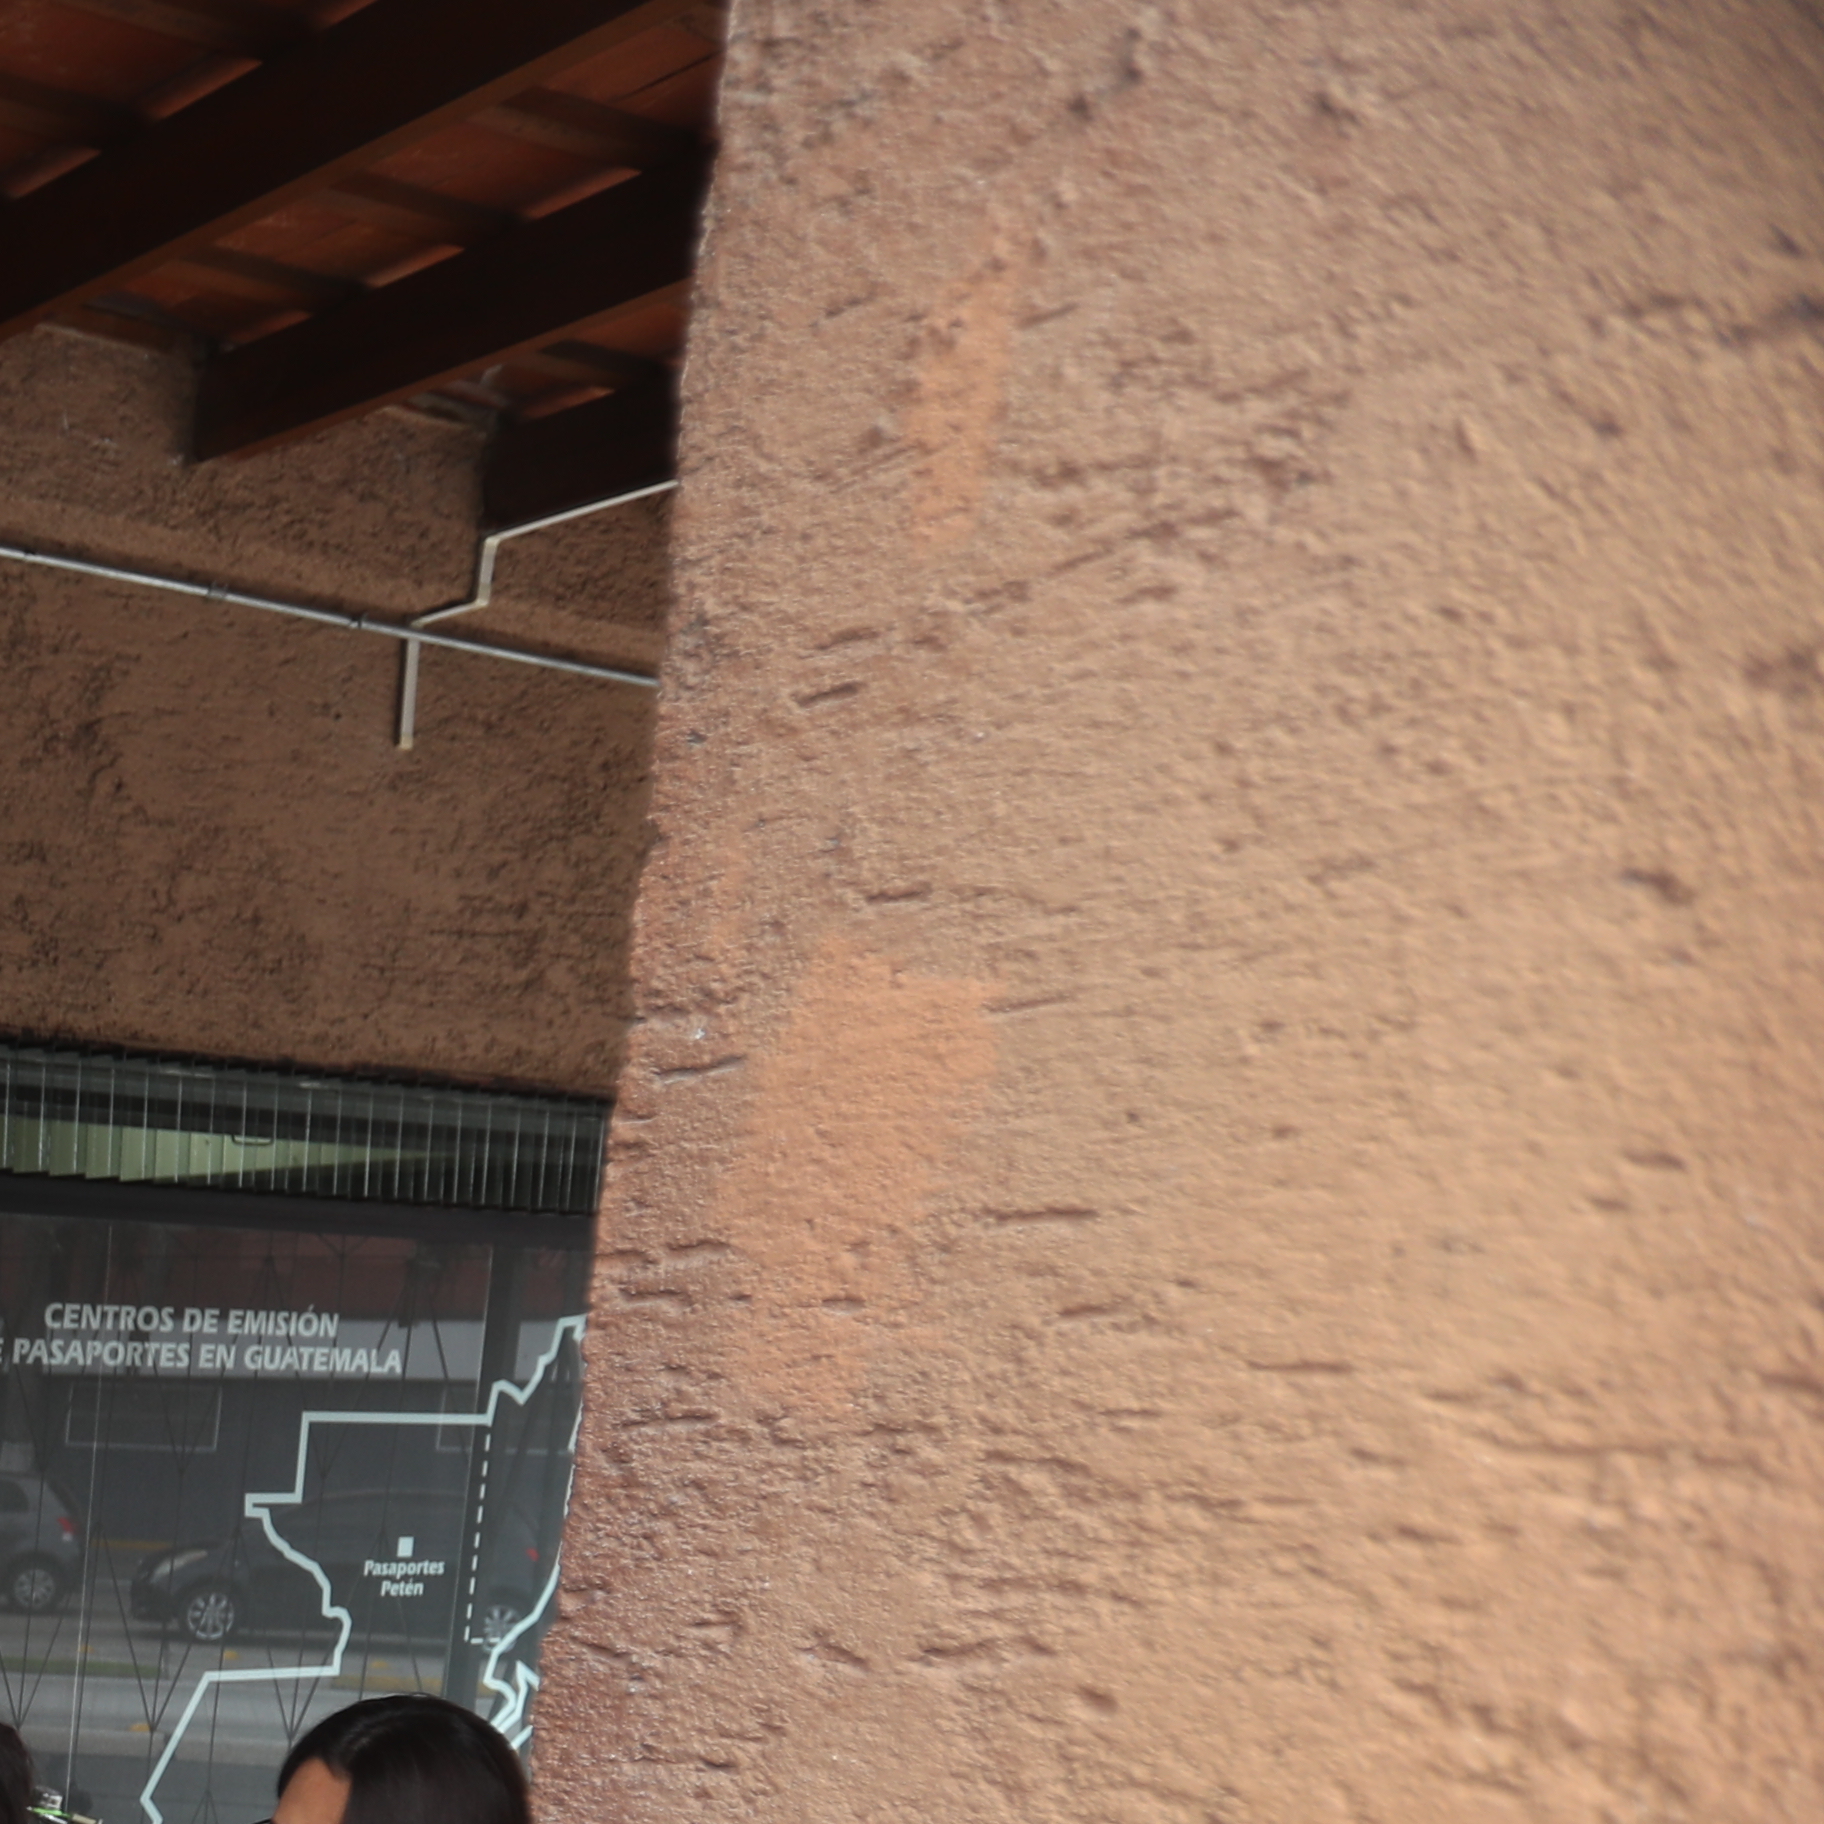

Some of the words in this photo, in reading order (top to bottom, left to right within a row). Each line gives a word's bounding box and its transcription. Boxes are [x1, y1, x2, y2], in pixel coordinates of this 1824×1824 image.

[44, 1302, 175, 1333] CENTROS
[182, 1307, 220, 1334] DE
[227, 1303, 340, 1338] EMISIÓN
[12, 1338, 191, 1369] PASAPORTES
[198, 1343, 237, 1370] EN
[244, 1345, 402, 1374] GUATEMALA
[363, 1560, 445, 1580] Pasaportes
[380, 1578, 424, 1597] Petén
